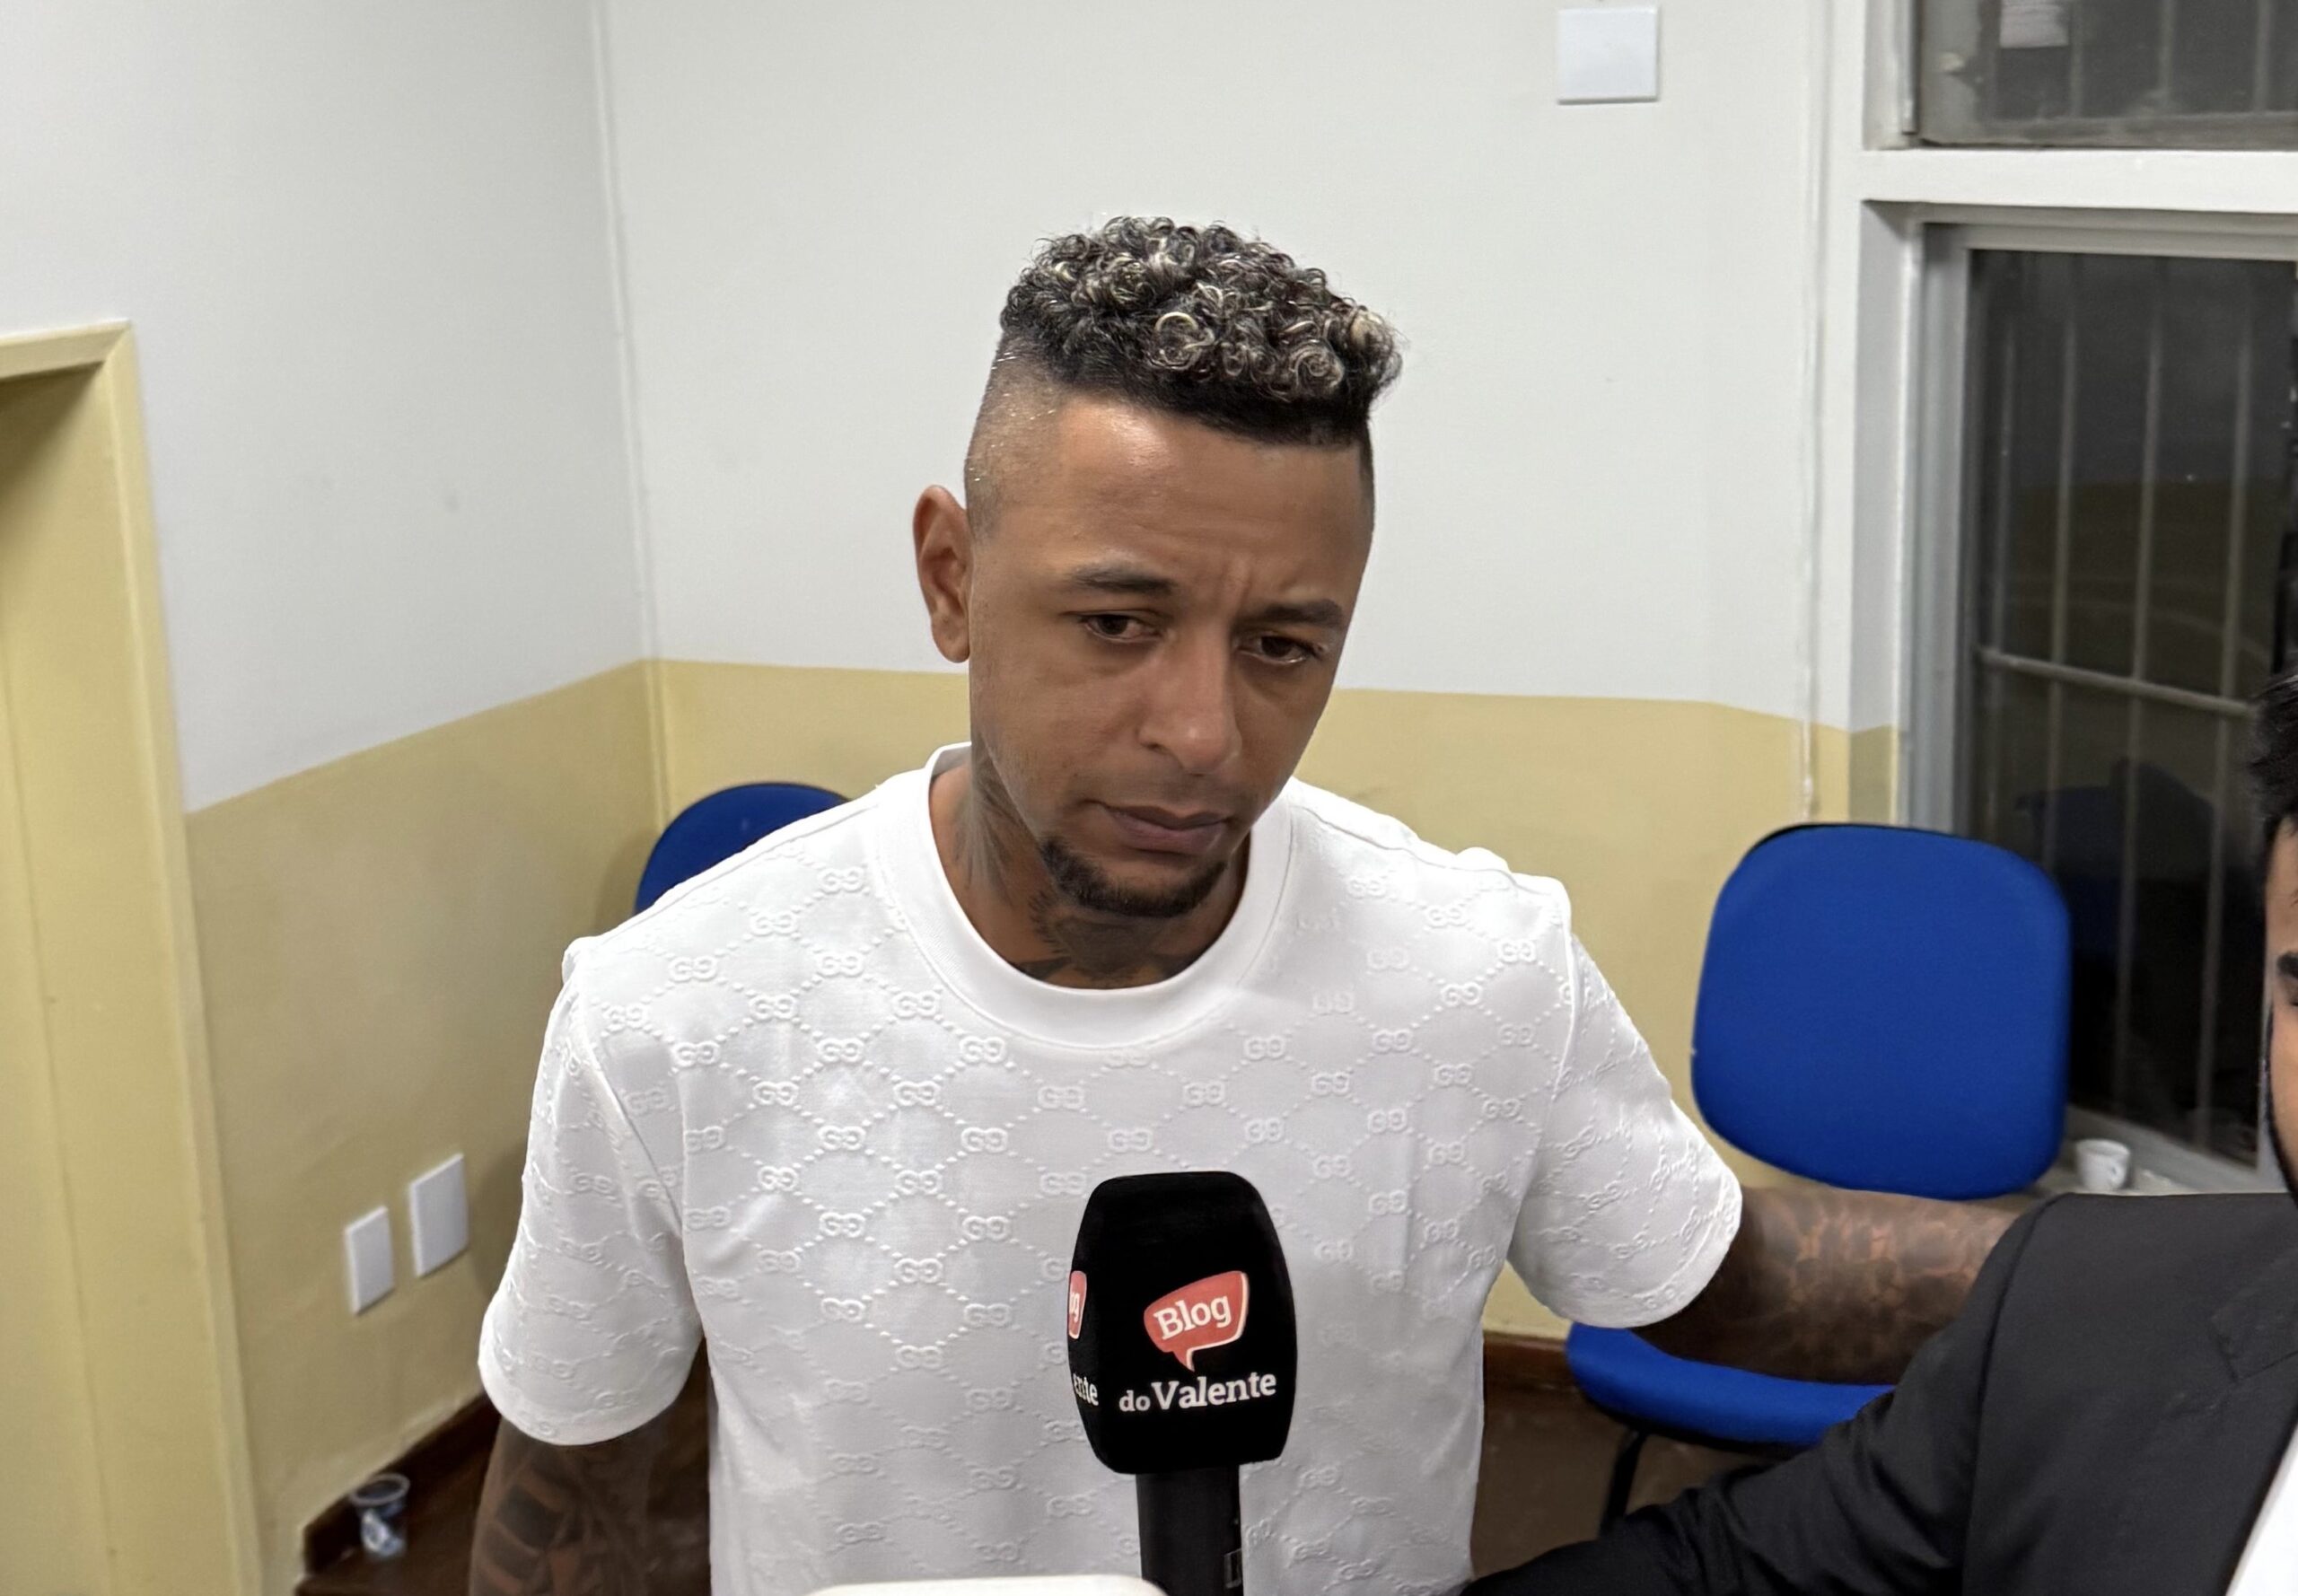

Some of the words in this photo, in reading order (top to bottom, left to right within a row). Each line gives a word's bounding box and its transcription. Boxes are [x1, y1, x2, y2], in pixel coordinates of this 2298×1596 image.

[1153, 1295, 1232, 1340] Blog
[1118, 1390, 1151, 1412] do
[1151, 1372, 1276, 1409] Valente
